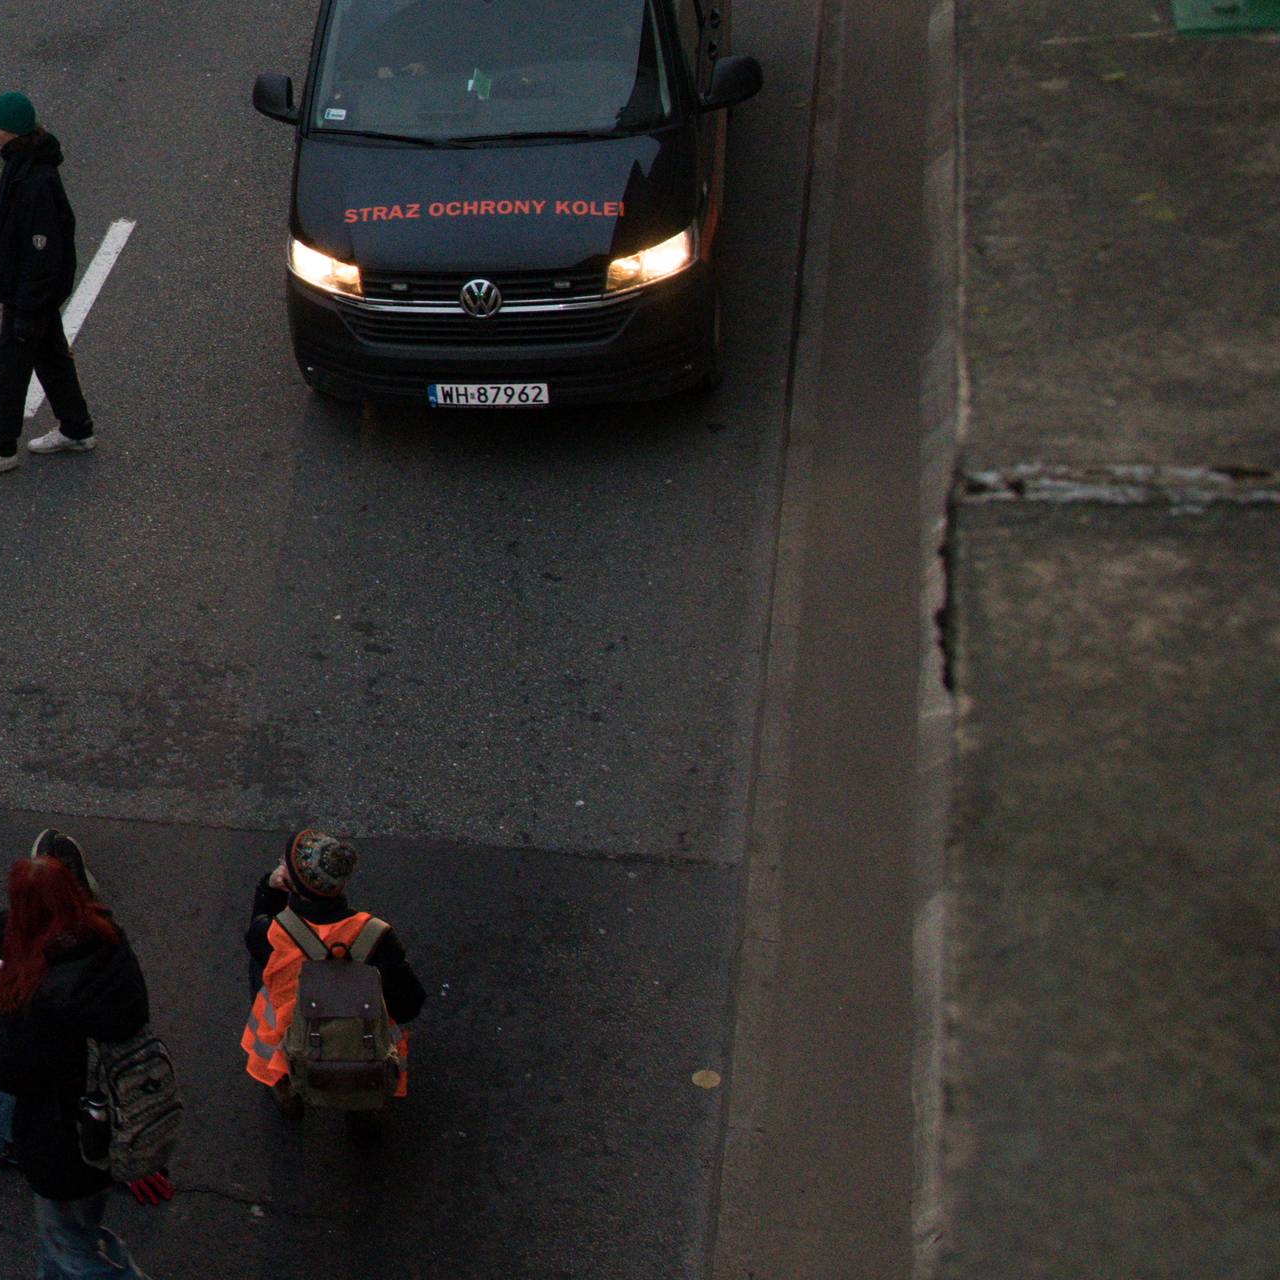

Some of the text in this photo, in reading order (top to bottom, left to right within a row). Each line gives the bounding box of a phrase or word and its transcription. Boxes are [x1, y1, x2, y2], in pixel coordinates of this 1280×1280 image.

[428, 199, 546, 218] OCHRONY
[554, 199, 625, 217] KOLEI
[441, 385, 544, 404] WH 87962
